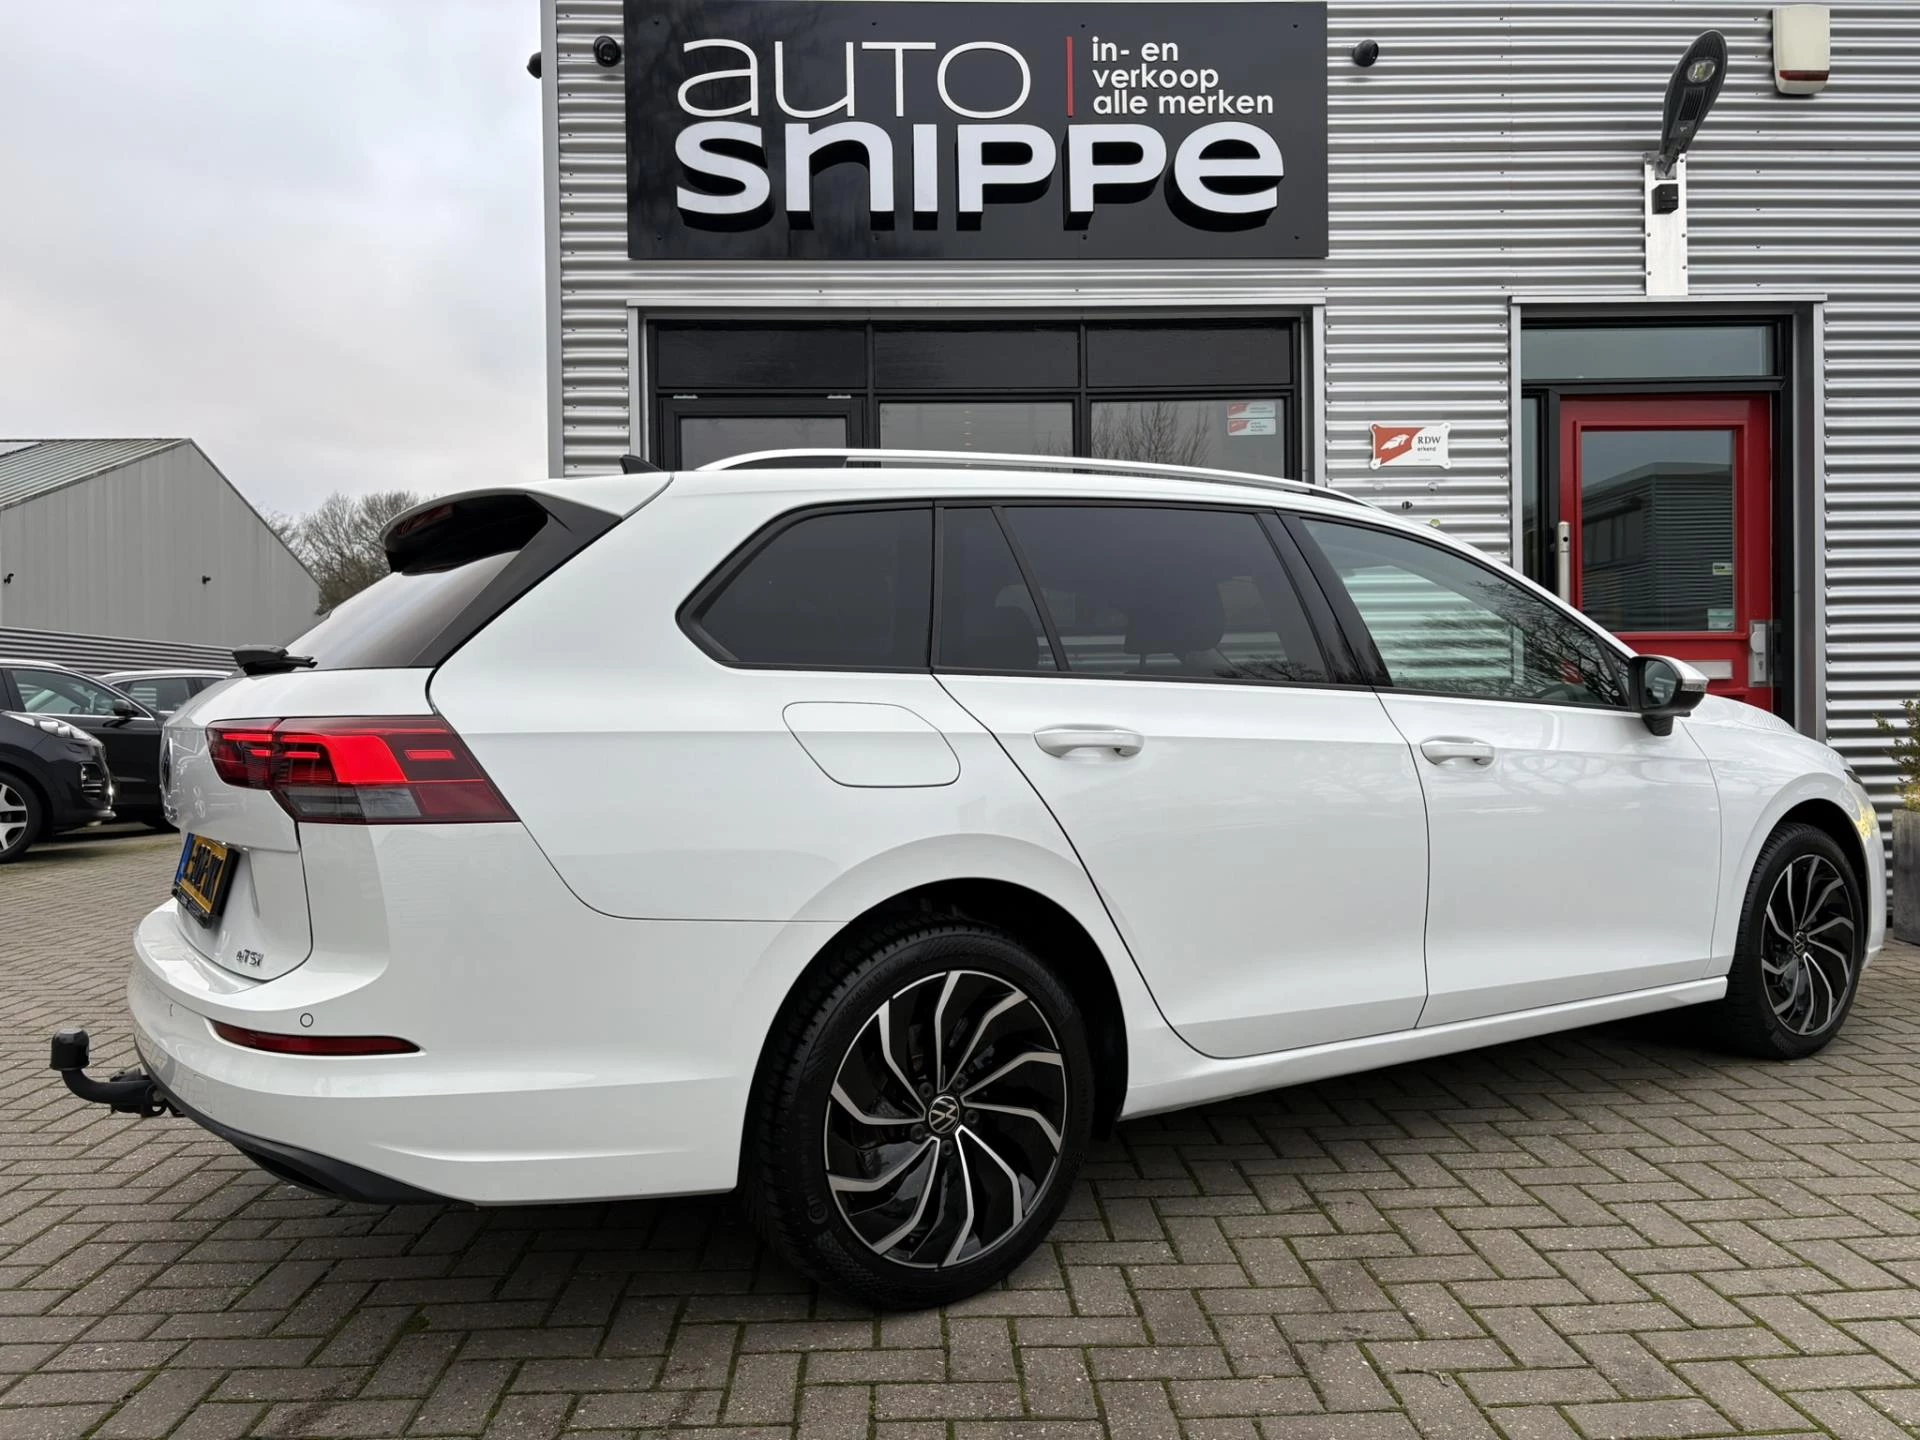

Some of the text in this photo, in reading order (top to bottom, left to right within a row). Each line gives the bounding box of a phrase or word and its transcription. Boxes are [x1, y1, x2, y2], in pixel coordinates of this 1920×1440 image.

[1092, 36, 1179, 62] in- en
[1092, 63, 1219, 94] verkoop
[1093, 89, 1274, 115] alle merken
[1417, 436, 1441, 444] RDW
